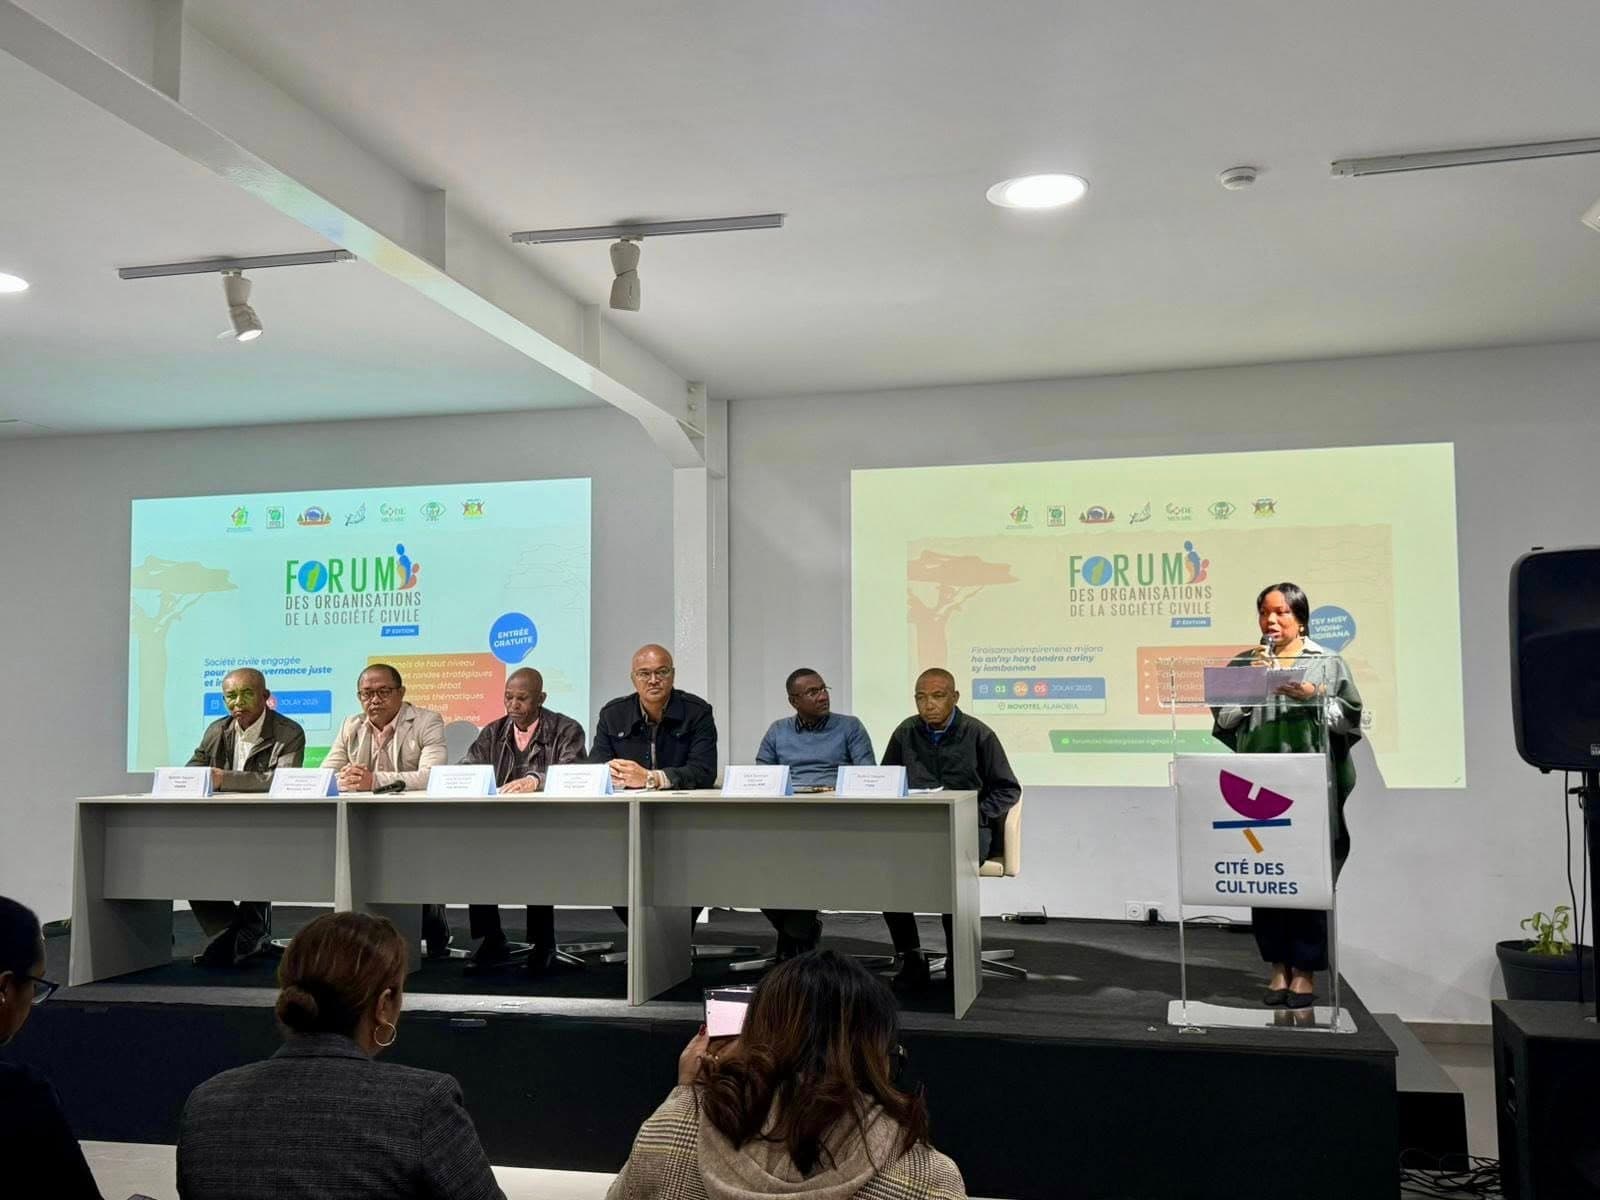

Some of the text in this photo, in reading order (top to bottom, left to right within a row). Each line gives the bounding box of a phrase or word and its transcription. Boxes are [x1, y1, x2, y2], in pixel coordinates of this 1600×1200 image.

[285, 556, 395, 594] FORUM
[1069, 553, 1183, 587] FORUM
[285, 592, 421, 610] DES ORGANISATIONS
[1070, 586, 1212, 602] DES ORGANISATIONS
[1070, 602, 1211, 617] DE LA SOCIÉTÉ CIVILE
[285, 609, 420, 626] DE LA SOCIÉTÉ CIVILE
[497, 627, 529, 639] ENTRÉE
[494, 636, 533, 648] GRATUITE
[204, 656, 301, 667] Société civile engagée
[427, 660, 445, 668] haut
[448, 660, 475, 668] niveau
[204, 669, 225, 679] pour
[308, 665, 332, 676] juste
[442, 670, 493, 679] stratégiques
[972, 665, 982, 673] sy
[204, 679, 213, 687] et
[432, 692, 485, 702] thématiques
[1215, 858, 1285, 875] CITÉ DES
[1215, 880, 1298, 895] CULTURES
